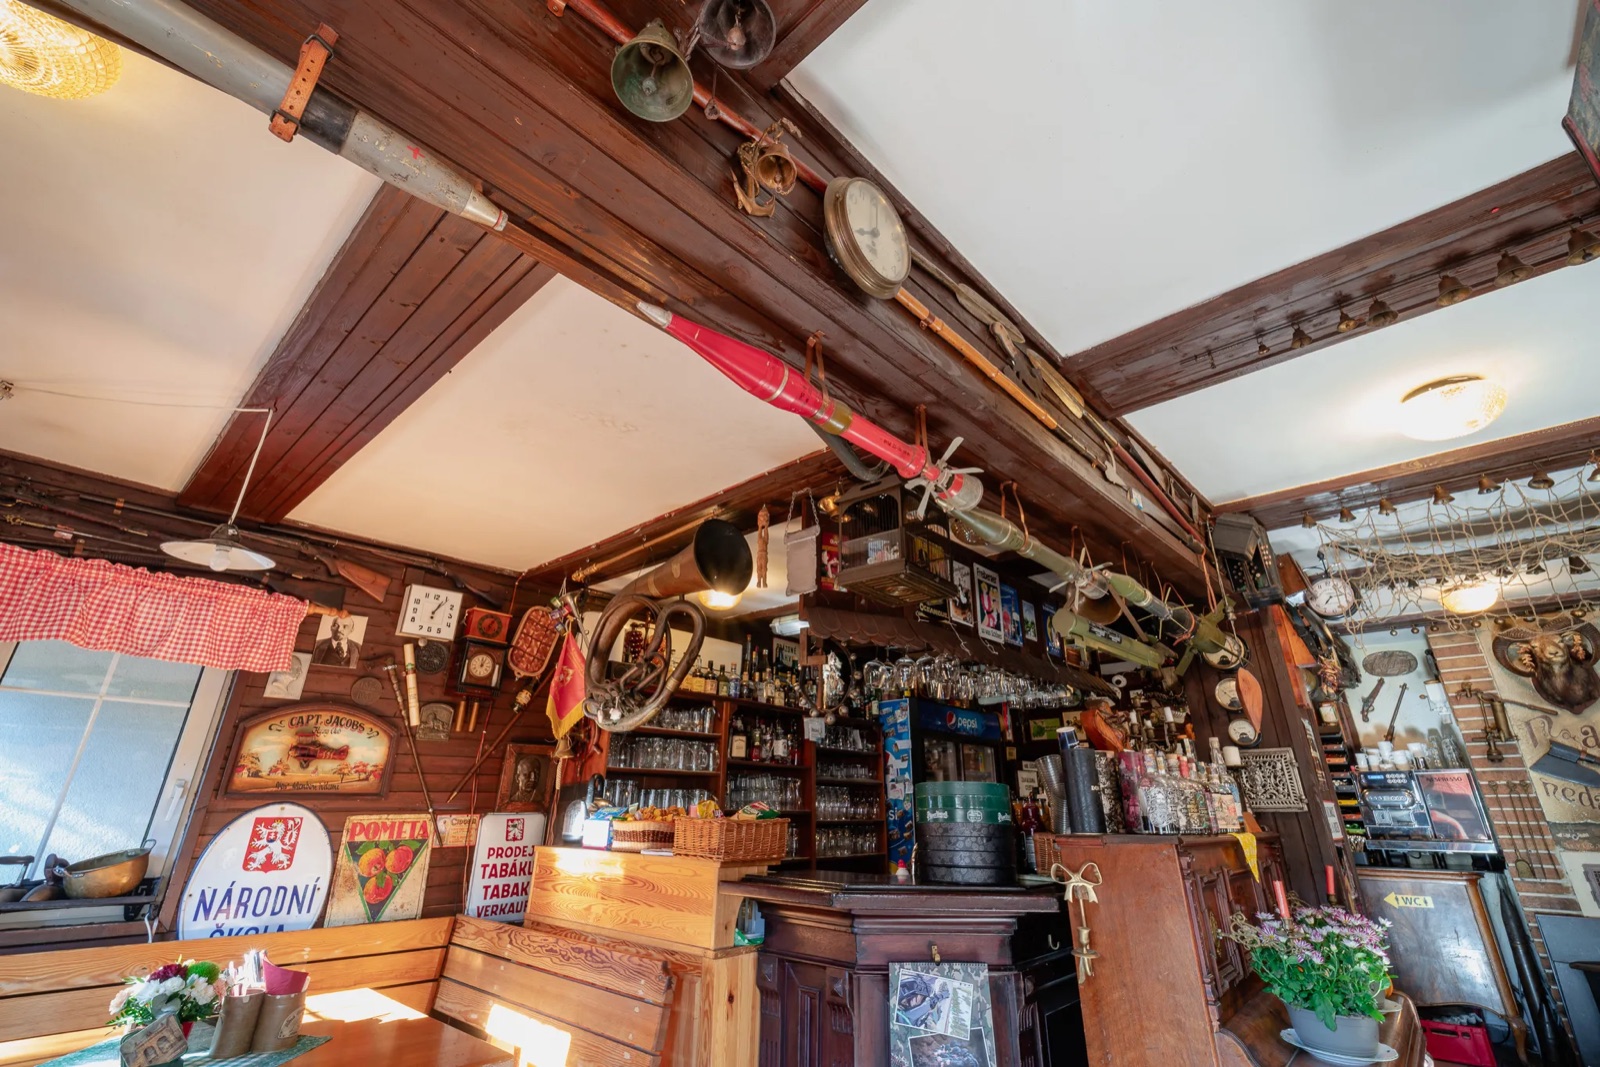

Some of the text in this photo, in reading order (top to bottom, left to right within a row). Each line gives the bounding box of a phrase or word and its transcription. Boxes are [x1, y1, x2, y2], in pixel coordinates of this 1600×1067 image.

[324, 714, 366, 733] JACOBS
[957, 716, 978, 729] pepsi
[348, 819, 430, 842] POMETA
[487, 845, 535, 860] PRODEJ
[191, 876, 321, 923] NÁRODNÍ
[482, 880, 530, 901] TABAK
[1401, 895, 1421, 907] WC
